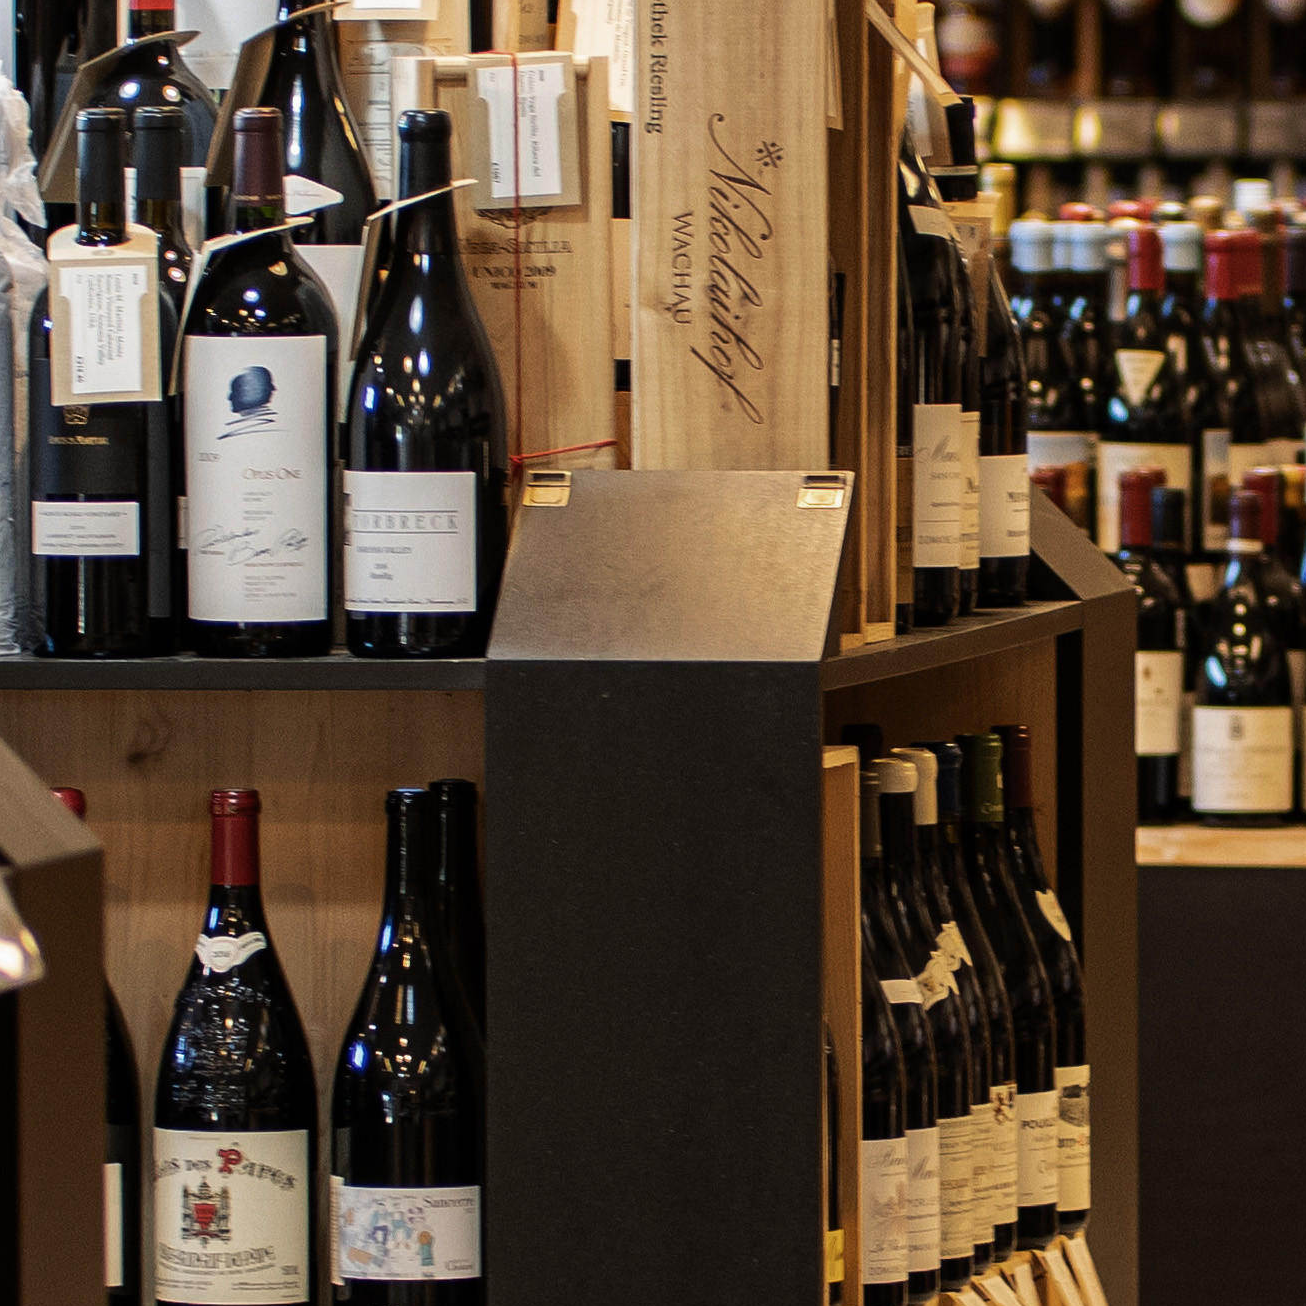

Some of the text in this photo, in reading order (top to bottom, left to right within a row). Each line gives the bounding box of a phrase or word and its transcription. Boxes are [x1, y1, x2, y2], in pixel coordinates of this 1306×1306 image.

[645, 54, 668, 135] Riesling
[671, 211, 695, 325] WACHAU
[689, 113, 773, 424] Nikolaihof
